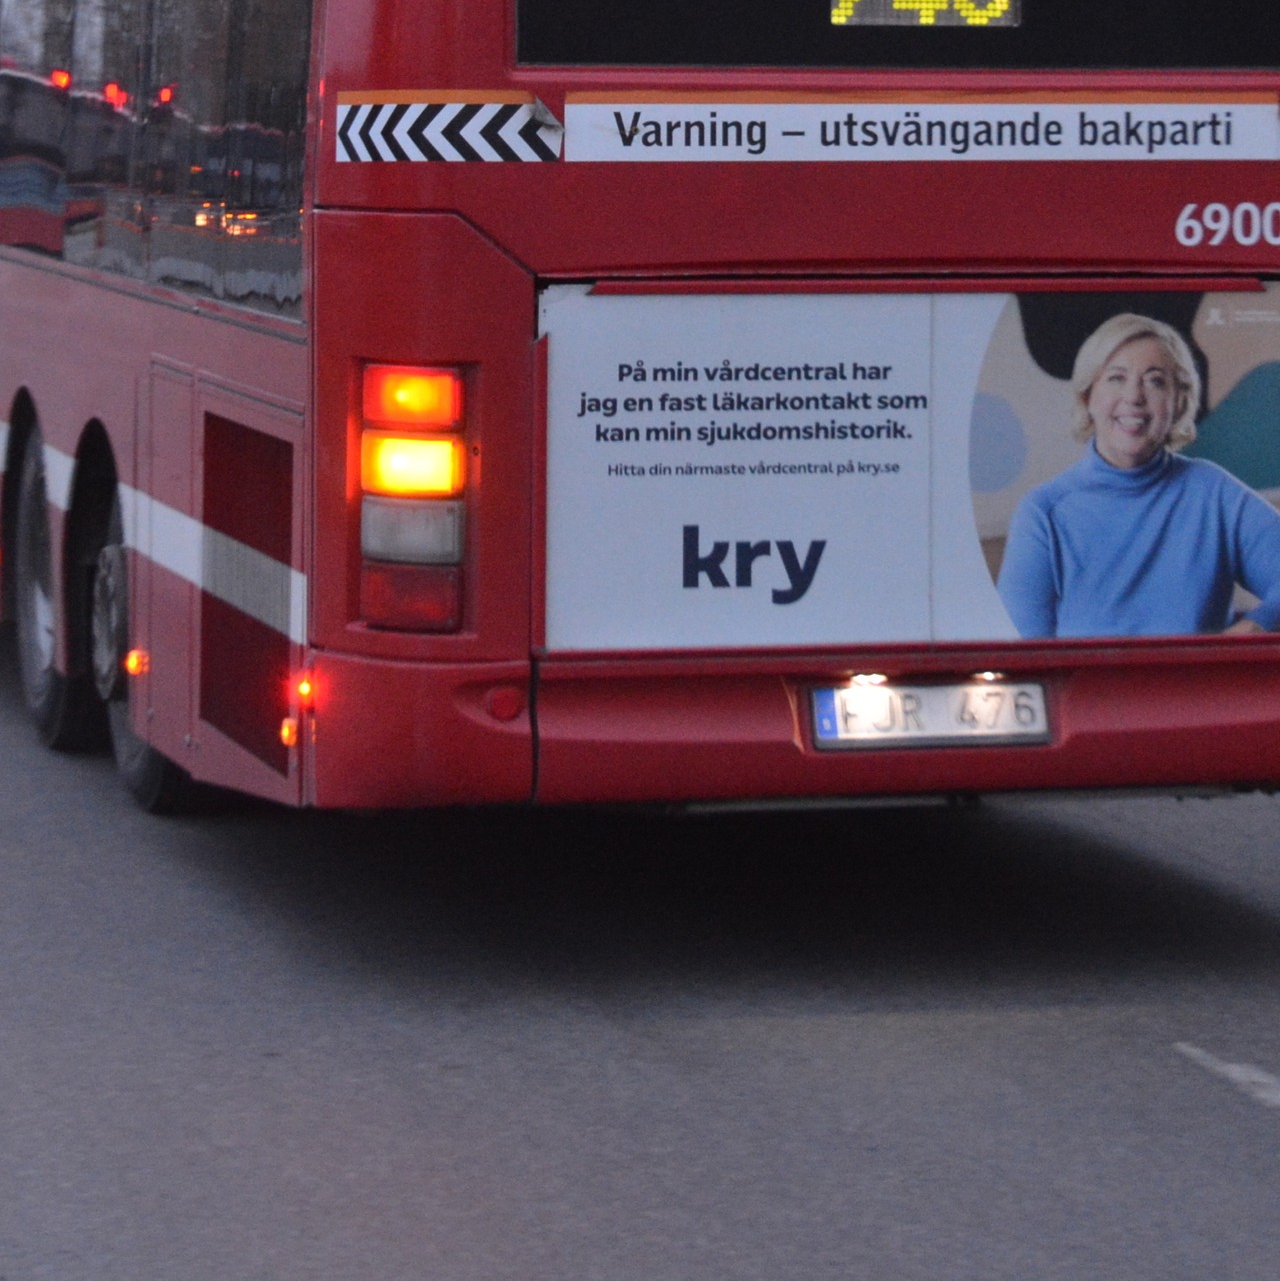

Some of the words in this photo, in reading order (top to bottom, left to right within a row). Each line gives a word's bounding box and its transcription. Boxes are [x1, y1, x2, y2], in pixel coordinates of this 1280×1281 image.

[613, 111, 768, 155] Varning
[820, 112, 1063, 155] utsvängande
[1079, 111, 1233, 153] bakparti
[618, 360, 648, 382] På
[652, 361, 699, 382] min
[703, 359, 848, 382] vårdcentral
[852, 362, 893, 381] har
[577, 392, 618, 417] jag
[622, 396, 654, 412] en
[658, 393, 708, 412] fast
[712, 392, 872, 412] läkarkontakt
[877, 394, 929, 410] som
[595, 424, 641, 442] kan
[645, 421, 692, 442] min
[696, 419, 914, 446] sjukdomshistorik.
[608, 463, 647, 476] Hitta
[649, 463, 672, 476] din
[675, 462, 746, 476] närmaste
[749, 460, 834, 476] vårdcentral
[836, 460, 855, 478] på
[858, 462, 901, 477] kry.se
[682, 524, 827, 605] kry
[957, 690, 1036, 729] 476
